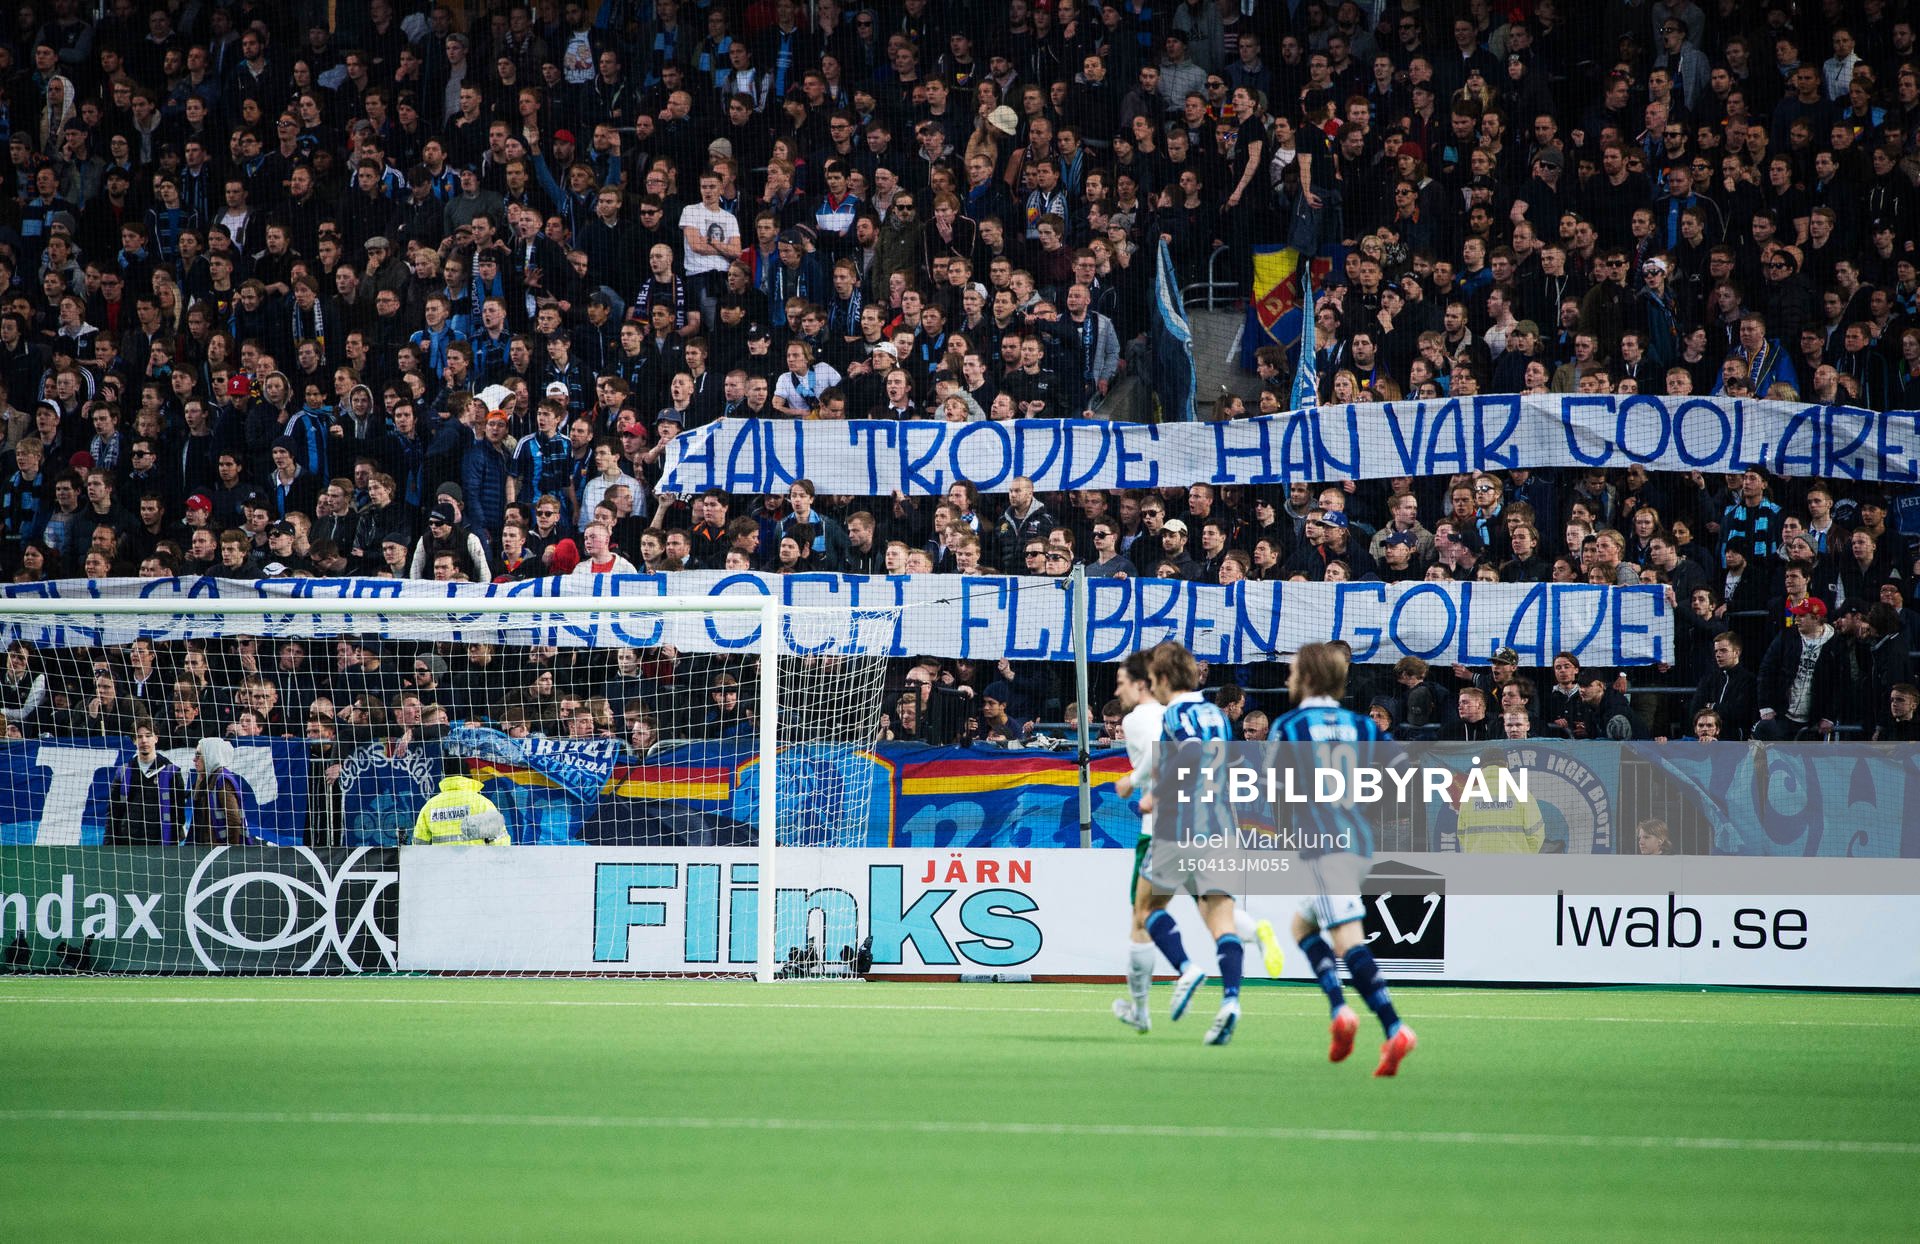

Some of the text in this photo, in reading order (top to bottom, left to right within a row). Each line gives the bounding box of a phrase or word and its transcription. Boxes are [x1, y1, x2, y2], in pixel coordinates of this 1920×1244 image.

[662, 394, 1919, 495] HAN TRODDE HAN VAR COOLARE
[704, 573, 910, 657] OCH
[960, 575, 1283, 664] FLIBBEN
[1331, 581, 1665, 668] GOLADE
[1507, 750, 1612, 849] ÄR INGET BROTT
[0, 874, 163, 940] ndax
[592, 862, 1043, 967] Flinks
[921, 853, 1032, 883] JÄRN
[1555, 889, 1808, 950] lwab.se
